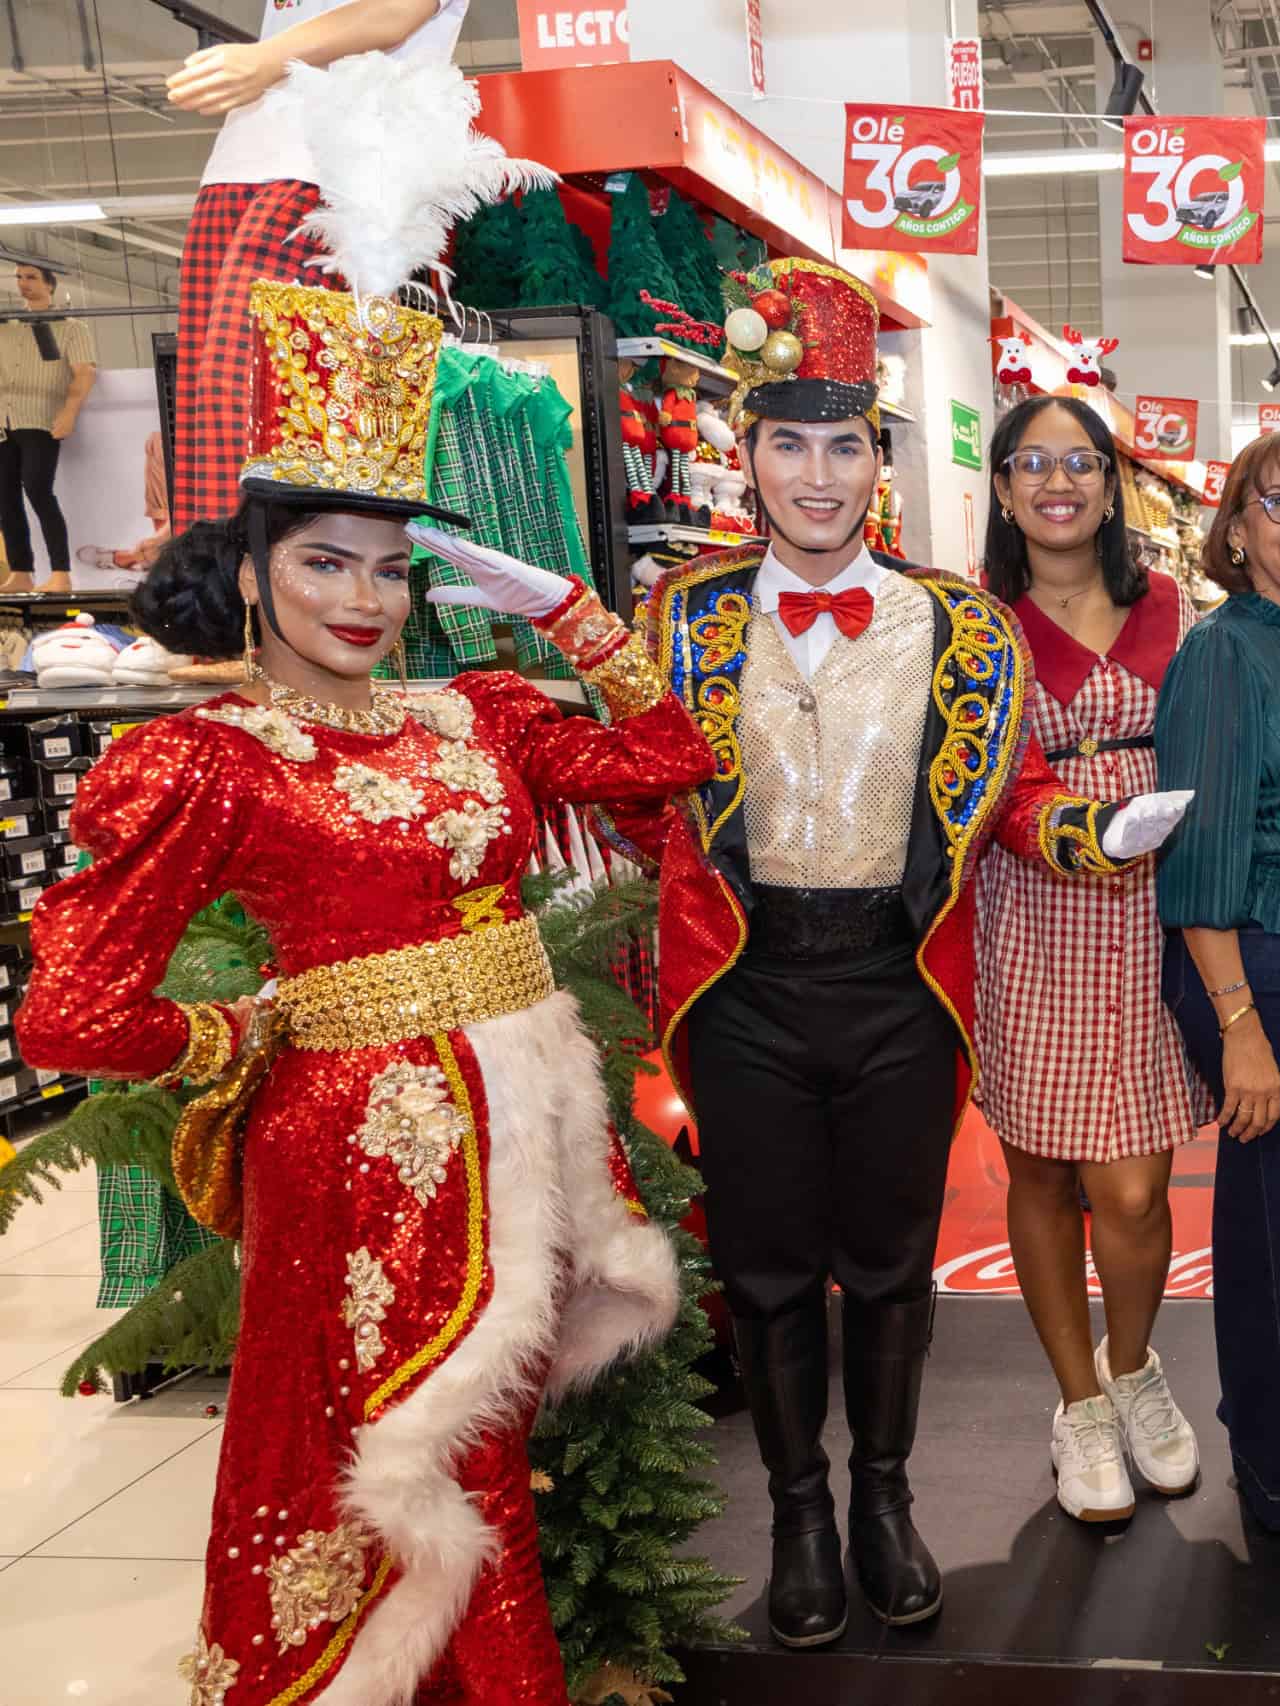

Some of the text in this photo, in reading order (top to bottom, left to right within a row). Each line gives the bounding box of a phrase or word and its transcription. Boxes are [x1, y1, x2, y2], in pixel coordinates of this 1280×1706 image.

[853, 116, 905, 142] Olé
[1132, 128, 1185, 154] Olé
[846, 143, 961, 229] 30
[1127, 154, 1244, 243] 30
[899, 207, 966, 233] AÑOS CONTIGO
[1182, 217, 1250, 244] AÑOS CONTIGO
[1135, 413, 1188, 450] 30
